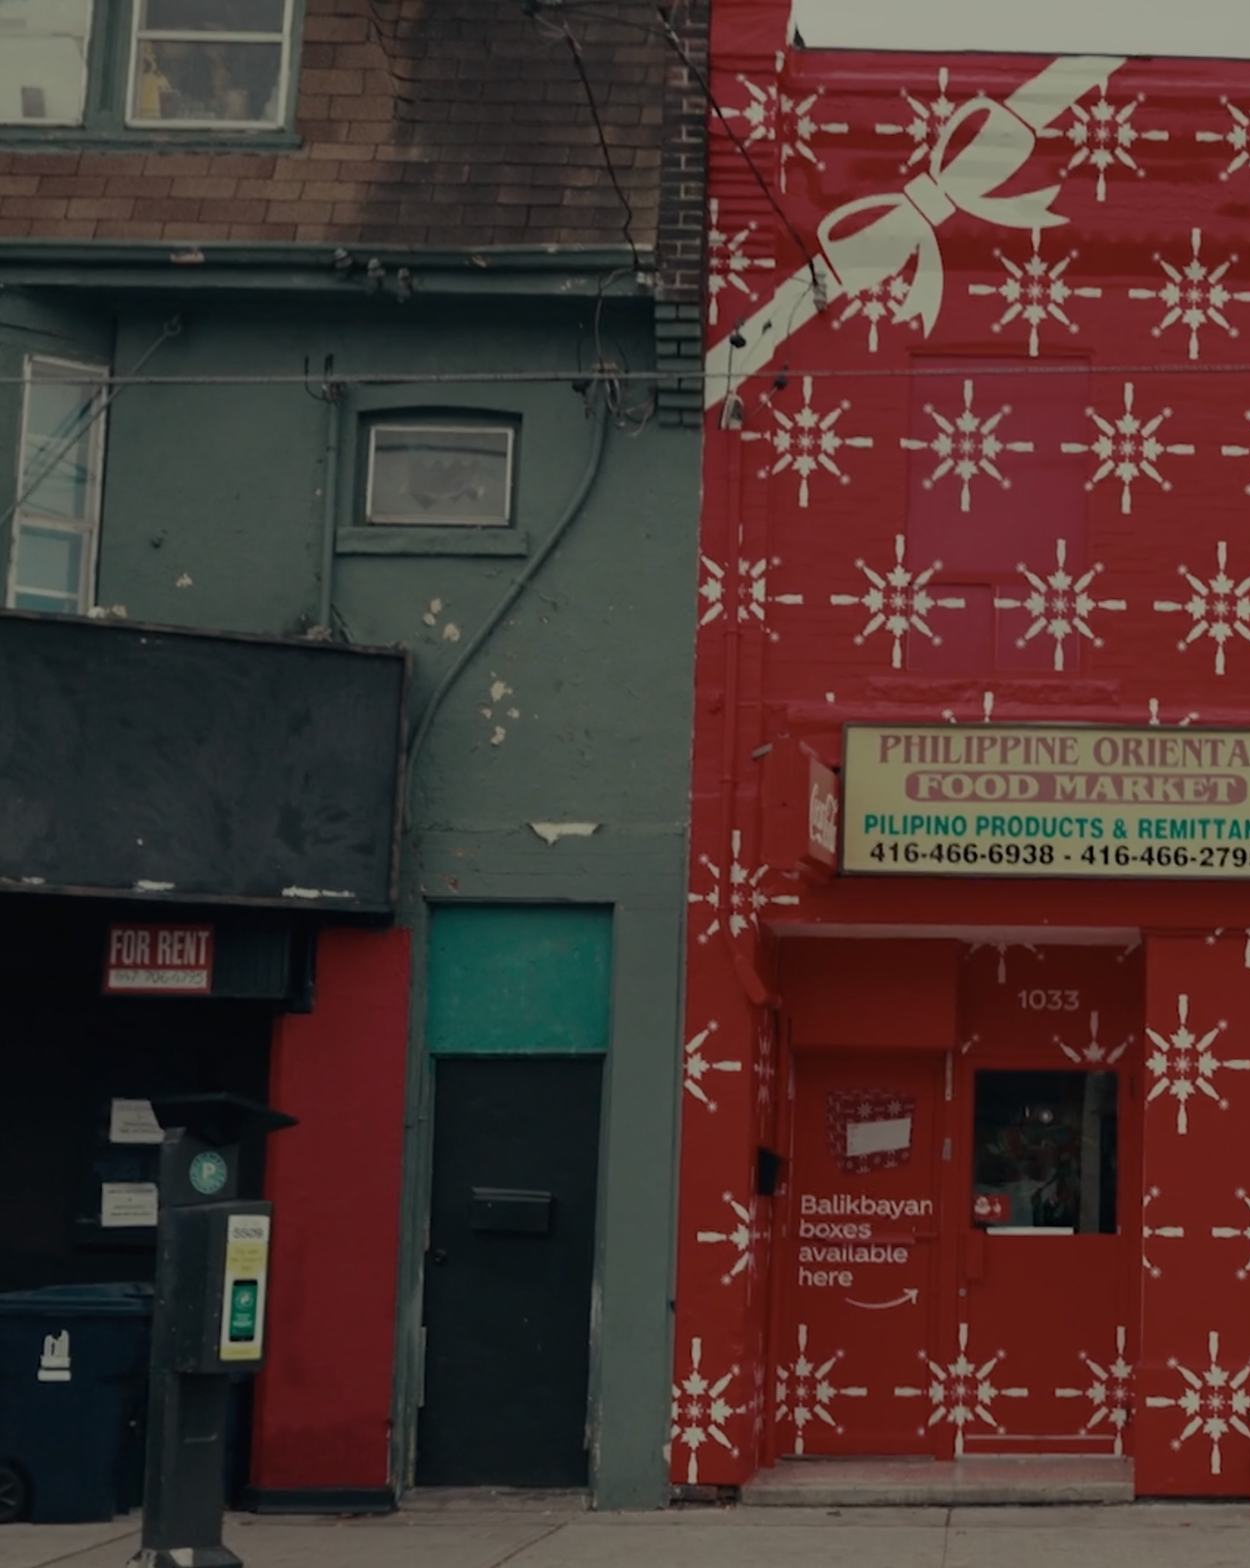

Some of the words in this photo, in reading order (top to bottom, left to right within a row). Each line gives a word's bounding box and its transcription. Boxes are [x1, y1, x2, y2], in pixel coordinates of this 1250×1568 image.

[879, 735, 1081, 765] PHILIPPINE
[916, 773, 1040, 800] FOOD
[1054, 775, 1237, 802] MARKET
[864, 815, 967, 836] PILIPINO
[976, 816, 1104, 838] PRODUCTS
[1113, 819, 1127, 839] &
[870, 842, 1054, 864] 416-466-6938
[110, 929, 150, 965] FOR
[157, 930, 209, 966] RENT
[1017, 988, 1080, 1012] 1033
[800, 1194, 933, 1220] Balikbayan
[799, 1218, 872, 1239] boxes
[798, 1244, 909, 1264] available
[798, 1266, 854, 1288] here
